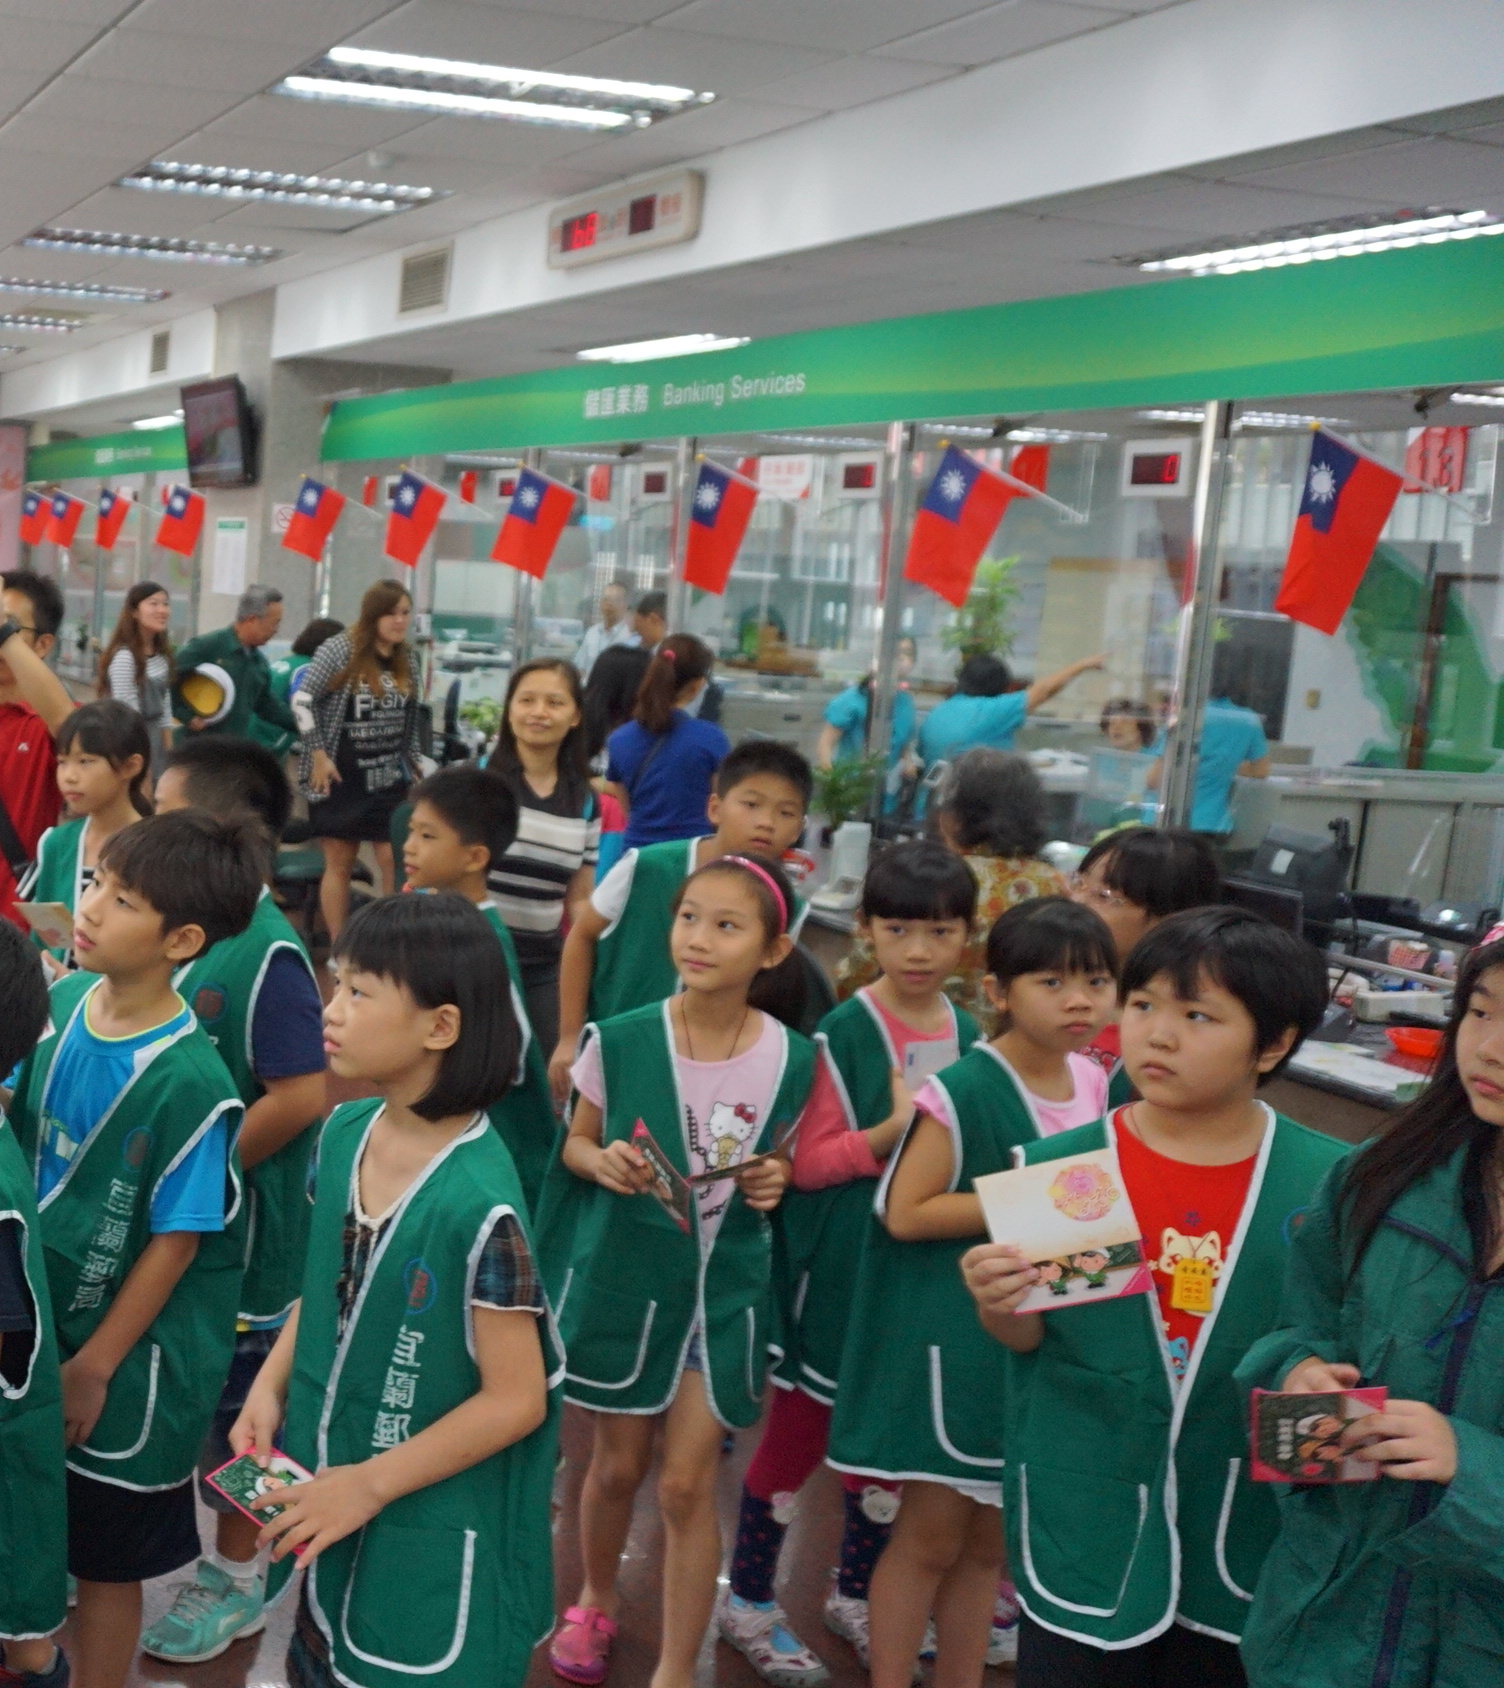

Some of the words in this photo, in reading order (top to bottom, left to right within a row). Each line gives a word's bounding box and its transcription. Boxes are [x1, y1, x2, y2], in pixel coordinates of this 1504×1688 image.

[662, 381, 725, 407] Banking
[730, 372, 806, 399] Services
[371, 1324, 425, 1458] 宜蘭郵
